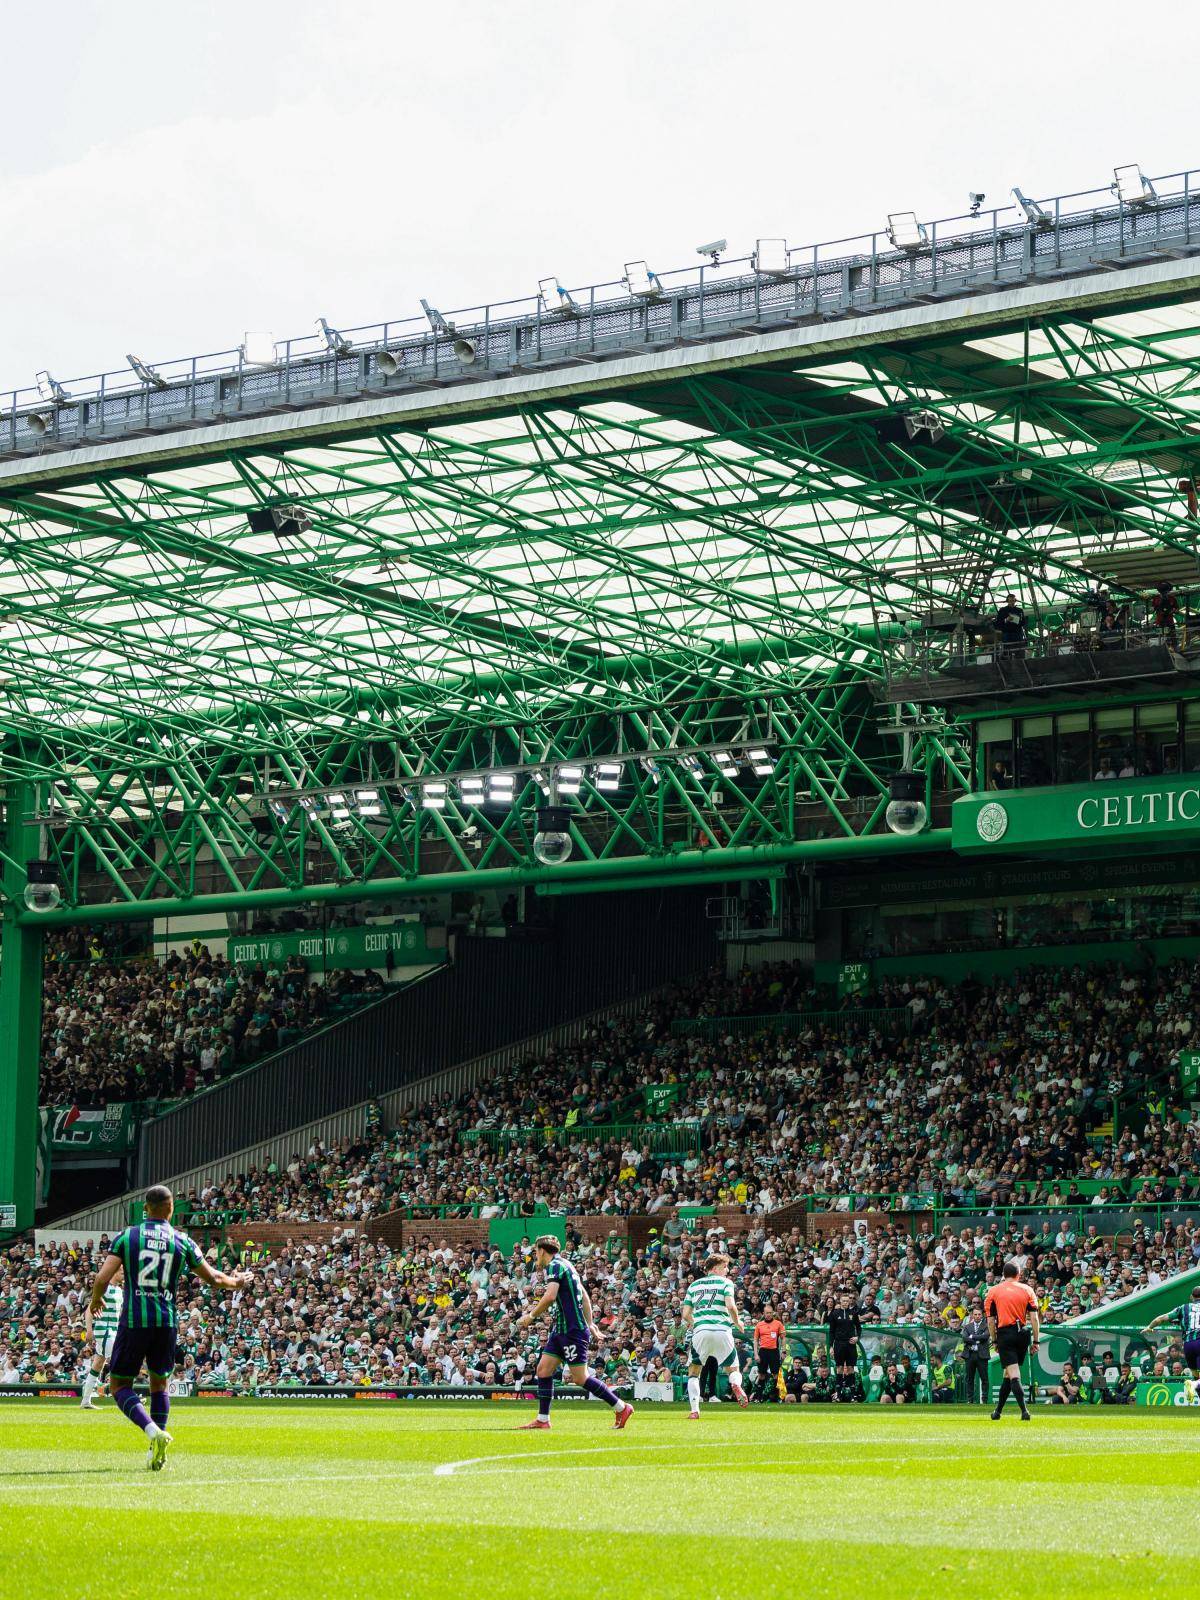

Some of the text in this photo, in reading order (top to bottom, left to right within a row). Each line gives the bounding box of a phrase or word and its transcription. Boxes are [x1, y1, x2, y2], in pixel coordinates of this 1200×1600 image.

[1077, 789, 1200, 829] CELTIC
[300, 938, 335, 956] CELTIC TV
[365, 932, 402, 951] CELTIC TV
[234, 943, 269, 962] CELTIC TV
[844, 964, 862, 973] EXIT
[653, 1090, 671, 1098] EXIT
[681, 1218, 696, 1228] XIT
[138, 1250, 174, 1288] 21
[695, 1288, 719, 1310] 27
[563, 1345, 578, 1358] 32
